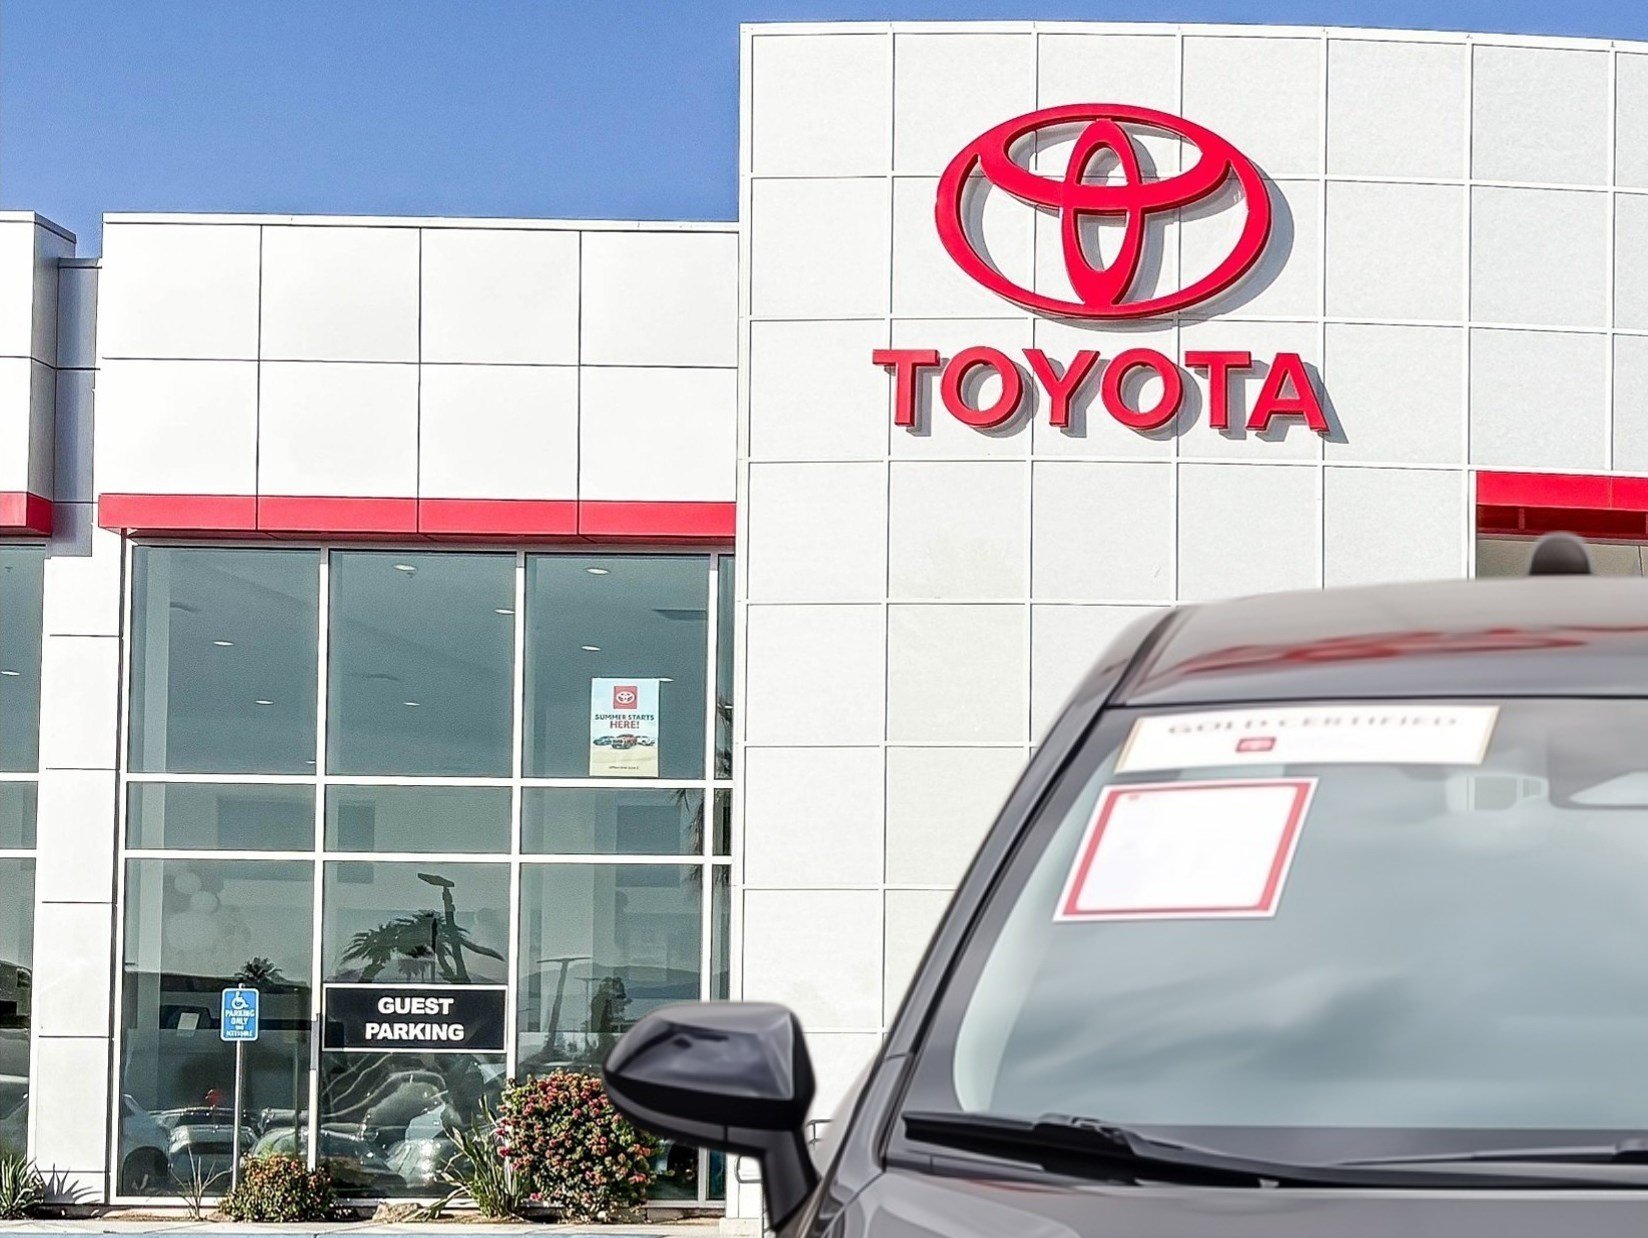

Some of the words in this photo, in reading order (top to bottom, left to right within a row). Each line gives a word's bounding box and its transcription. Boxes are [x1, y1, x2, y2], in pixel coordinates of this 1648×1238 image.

[872, 346, 1330, 432] TOYOTA
[609, 720, 640, 729] HERE!
[377, 997, 454, 1015] GUEST
[365, 1023, 465, 1041] PARKING
